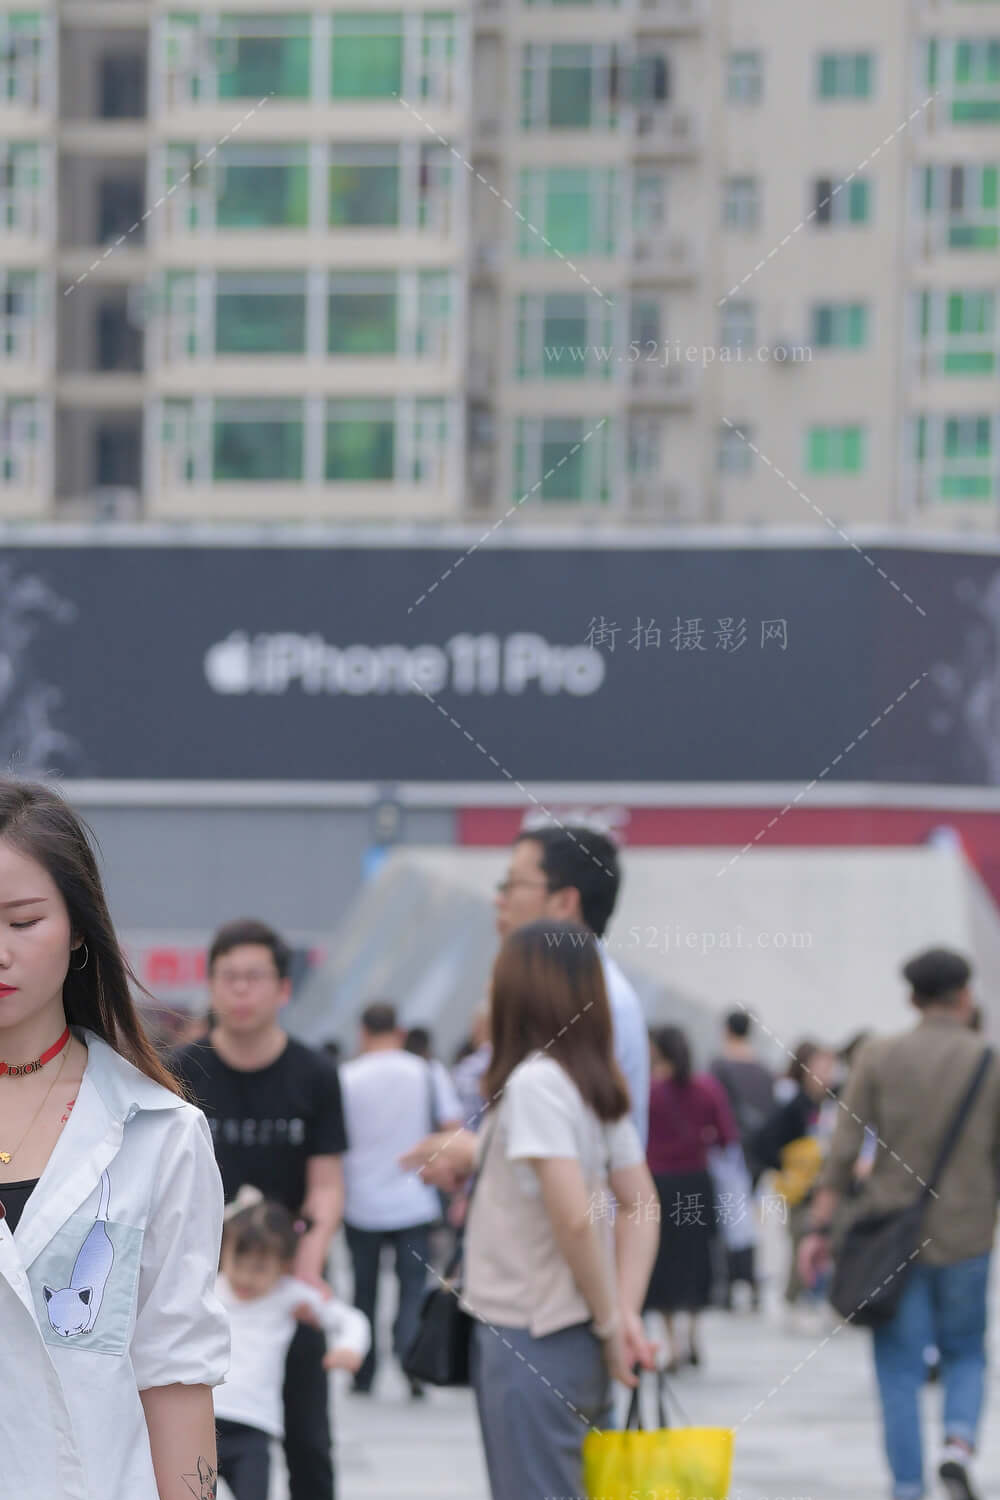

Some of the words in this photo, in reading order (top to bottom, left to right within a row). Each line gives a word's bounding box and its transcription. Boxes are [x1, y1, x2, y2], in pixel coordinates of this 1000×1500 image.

[249, 632, 448, 696] iPhone
[446, 632, 501, 696] 11
[503, 632, 606, 697] Pro
